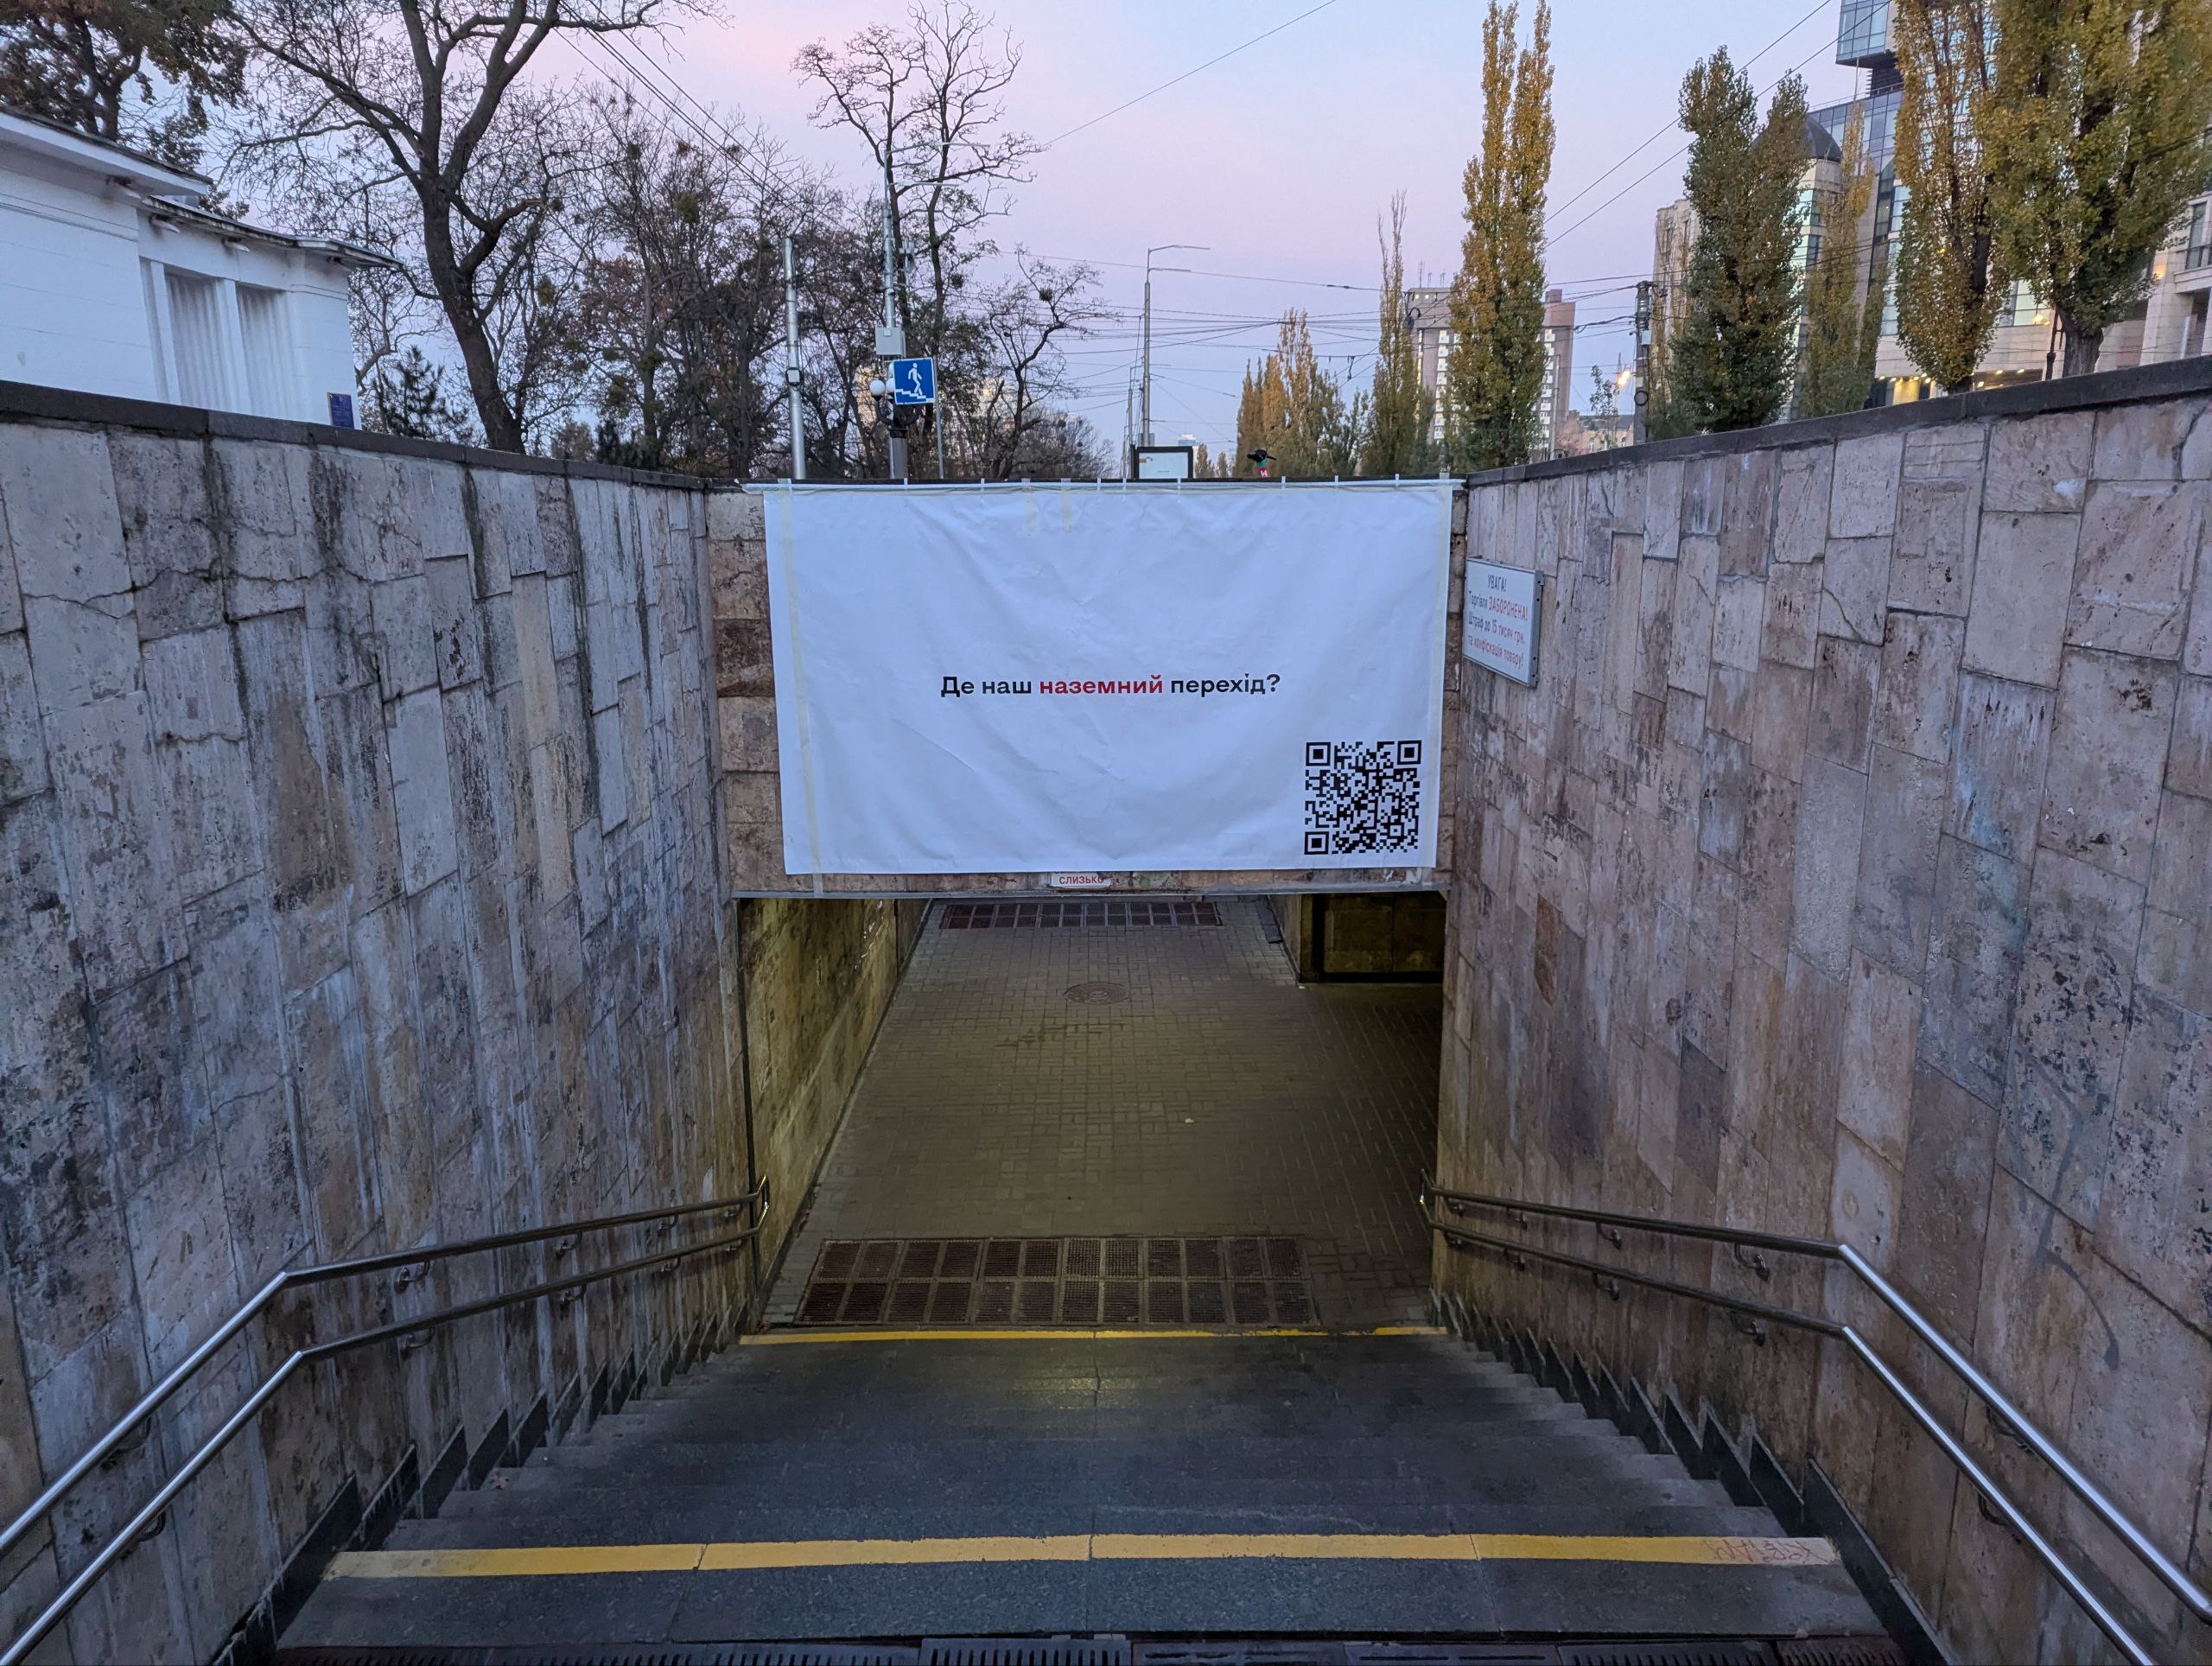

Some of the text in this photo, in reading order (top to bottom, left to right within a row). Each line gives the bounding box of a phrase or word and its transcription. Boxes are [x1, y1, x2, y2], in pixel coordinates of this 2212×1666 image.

[1487, 574, 1507, 592] УВАГА!
[1489, 595, 1529, 621] ЗАБОРОНЕНА!
[1491, 619, 1497, 633] 15
[940, 673, 1281, 697] Де наш наземний перехід?
[1058, 875, 1105, 884] СЛИЗЬКО
